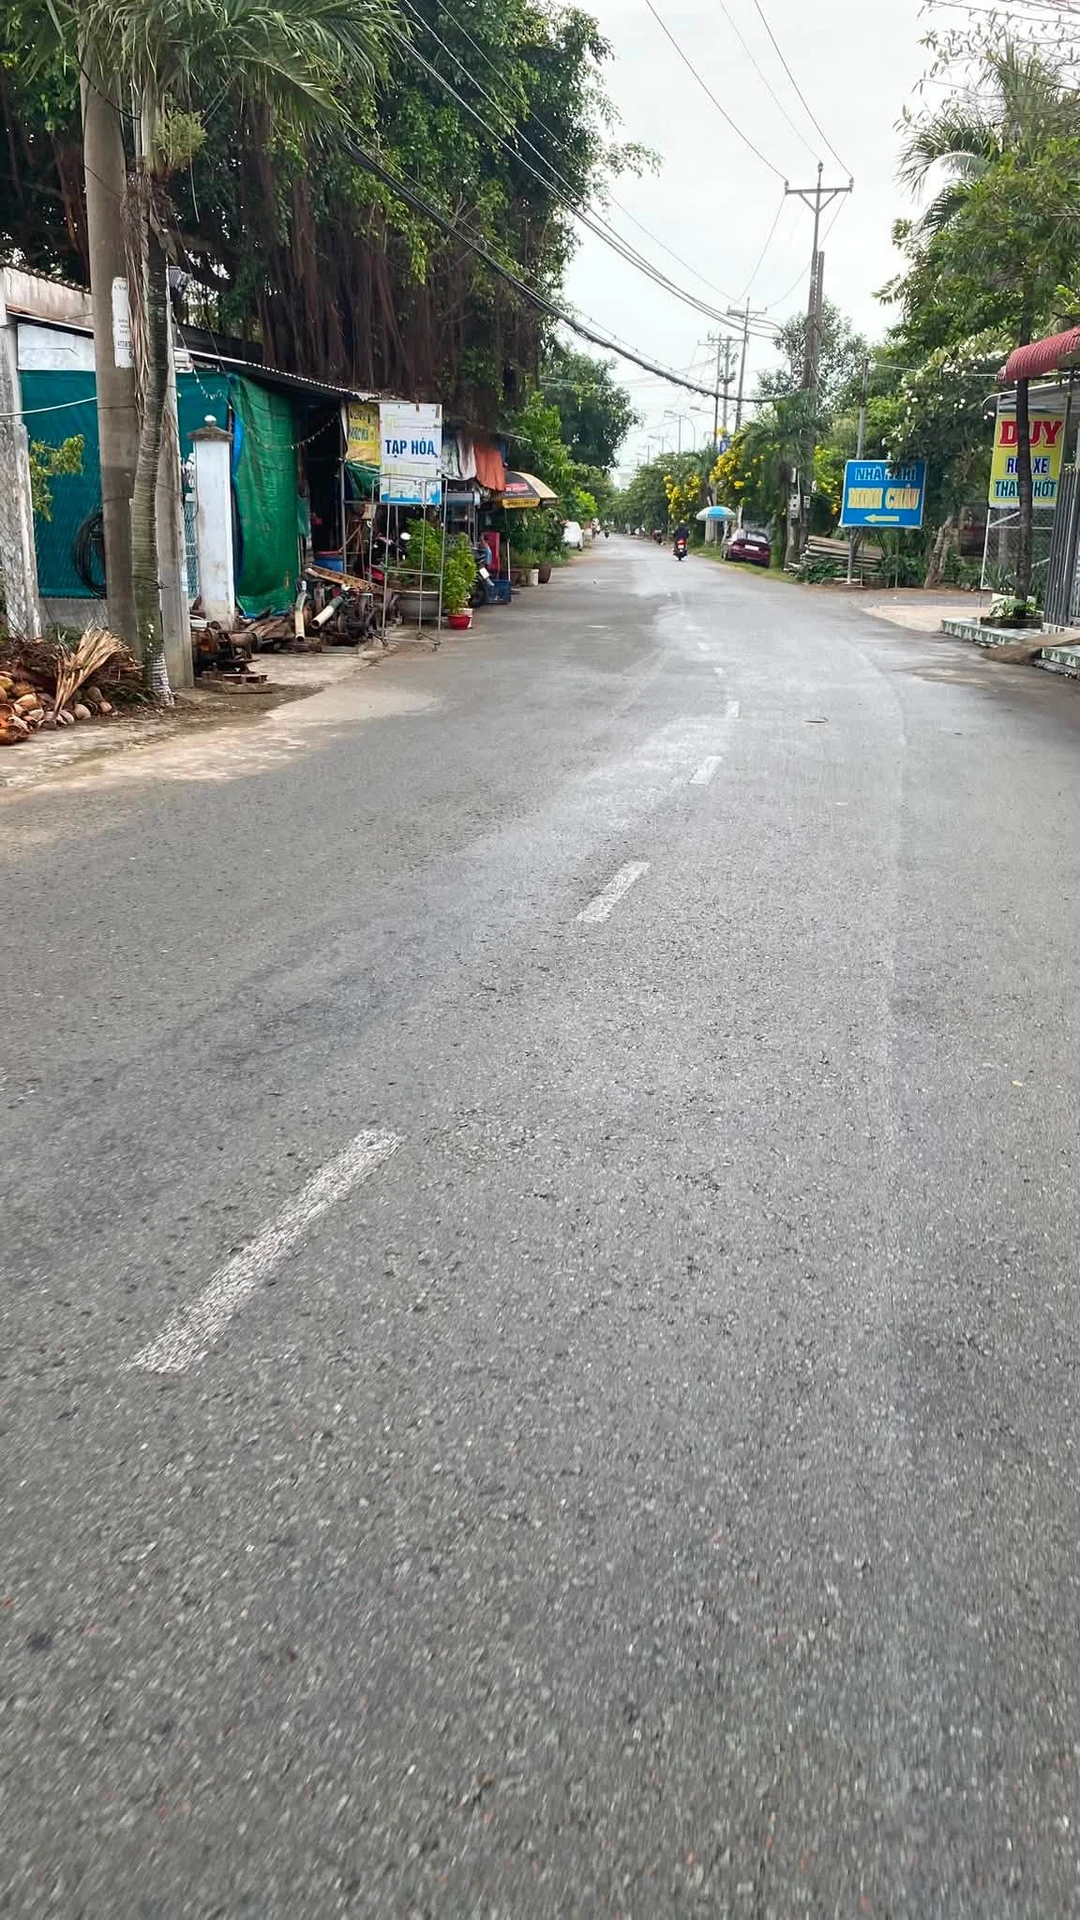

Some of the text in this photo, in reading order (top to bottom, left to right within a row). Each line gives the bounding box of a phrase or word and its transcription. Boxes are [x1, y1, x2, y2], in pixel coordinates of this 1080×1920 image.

[998, 420, 1063, 447] DUY
[385, 440, 407, 458] TẠP
[854, 466, 883, 481] NHÀ
[1032, 458, 1049, 474] XE
